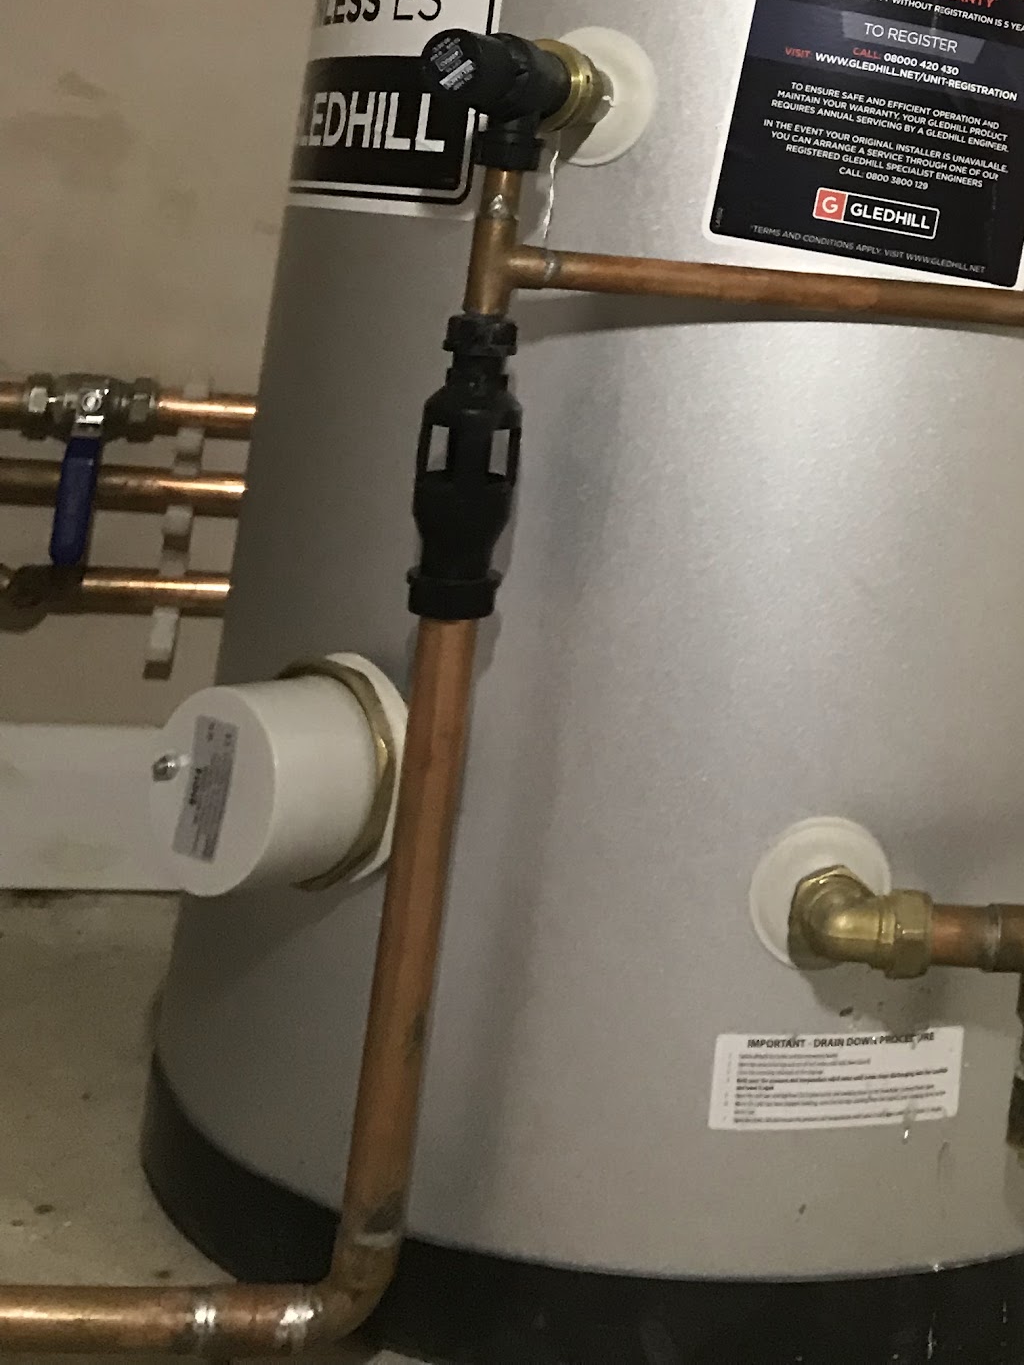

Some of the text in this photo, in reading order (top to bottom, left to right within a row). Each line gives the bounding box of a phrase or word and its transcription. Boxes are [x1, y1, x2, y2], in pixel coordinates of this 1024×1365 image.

[933, 4, 993, 24] REGISTRATION
[994, 18, 1002, 27] IS
[1003, 20, 1009, 28] 5
[864, 22, 957, 53] TO REGISTER
[815, 52, 1017, 101] WWW.GLEDHILL.NET/UNIT-REGISTRATION
[883, 52, 918, 67] 08000
[919, 60, 939, 71] 420
[940, 64, 959, 75] 430
[770, 99, 815, 114] REQUIRES
[816, 107, 854, 122] ANNUAL
[855, 114, 902, 131] SERVICING
[903, 123, 916, 133] BY
[916, 127, 924, 135] A
[925, 128, 966, 143] GLEDHILL
[776, 89, 821, 104] MAINTAIN
[822, 97, 847, 110] YOUR
[902, 113, 926, 125] YOUR
[927, 118, 968, 133] GLEDHILL
[791, 81, 999, 129] TO ENSURE SAFE AND EFFICIENT OPERATION AND
[763, 119, 773, 127] IN
[775, 120, 793, 131] THE
[793, 124, 824, 136] EVENT
[825, 129, 850, 141] YOUR
[851, 134, 894, 150] ORIGINAL
[895, 143, 941, 159] INSTALLER
[942, 152, 951, 160] IS
[771, 130, 790, 141] YOU
[791, 134, 812, 144] CAN
[812, 138, 856, 153] ARRANGE
[857, 146, 865, 154] A
[866, 148, 904, 162] SERVICE
[905, 155, 947, 170] THROUGH
[948, 163, 967, 174] ONE
[968, 167, 981, 176] OF
[785, 143, 982, 188] REGISTERED GLEDHILL SPECIALIST ENGINEERS
[865, 171, 889, 182] 0800
[890, 175, 913, 187] 3800
[914, 180, 928, 190] 129
[819, 196, 930, 229] G GLEDHILL
[781, 230, 802, 241] AND
[801, 233, 855, 251] CONDITIONS
[883, 248, 904, 259] VISIT
[747, 1039, 806, 1048] IMPORTANT
[813, 1038, 845, 1047] DRAIN
[846, 1036, 877, 1046] DOWN
